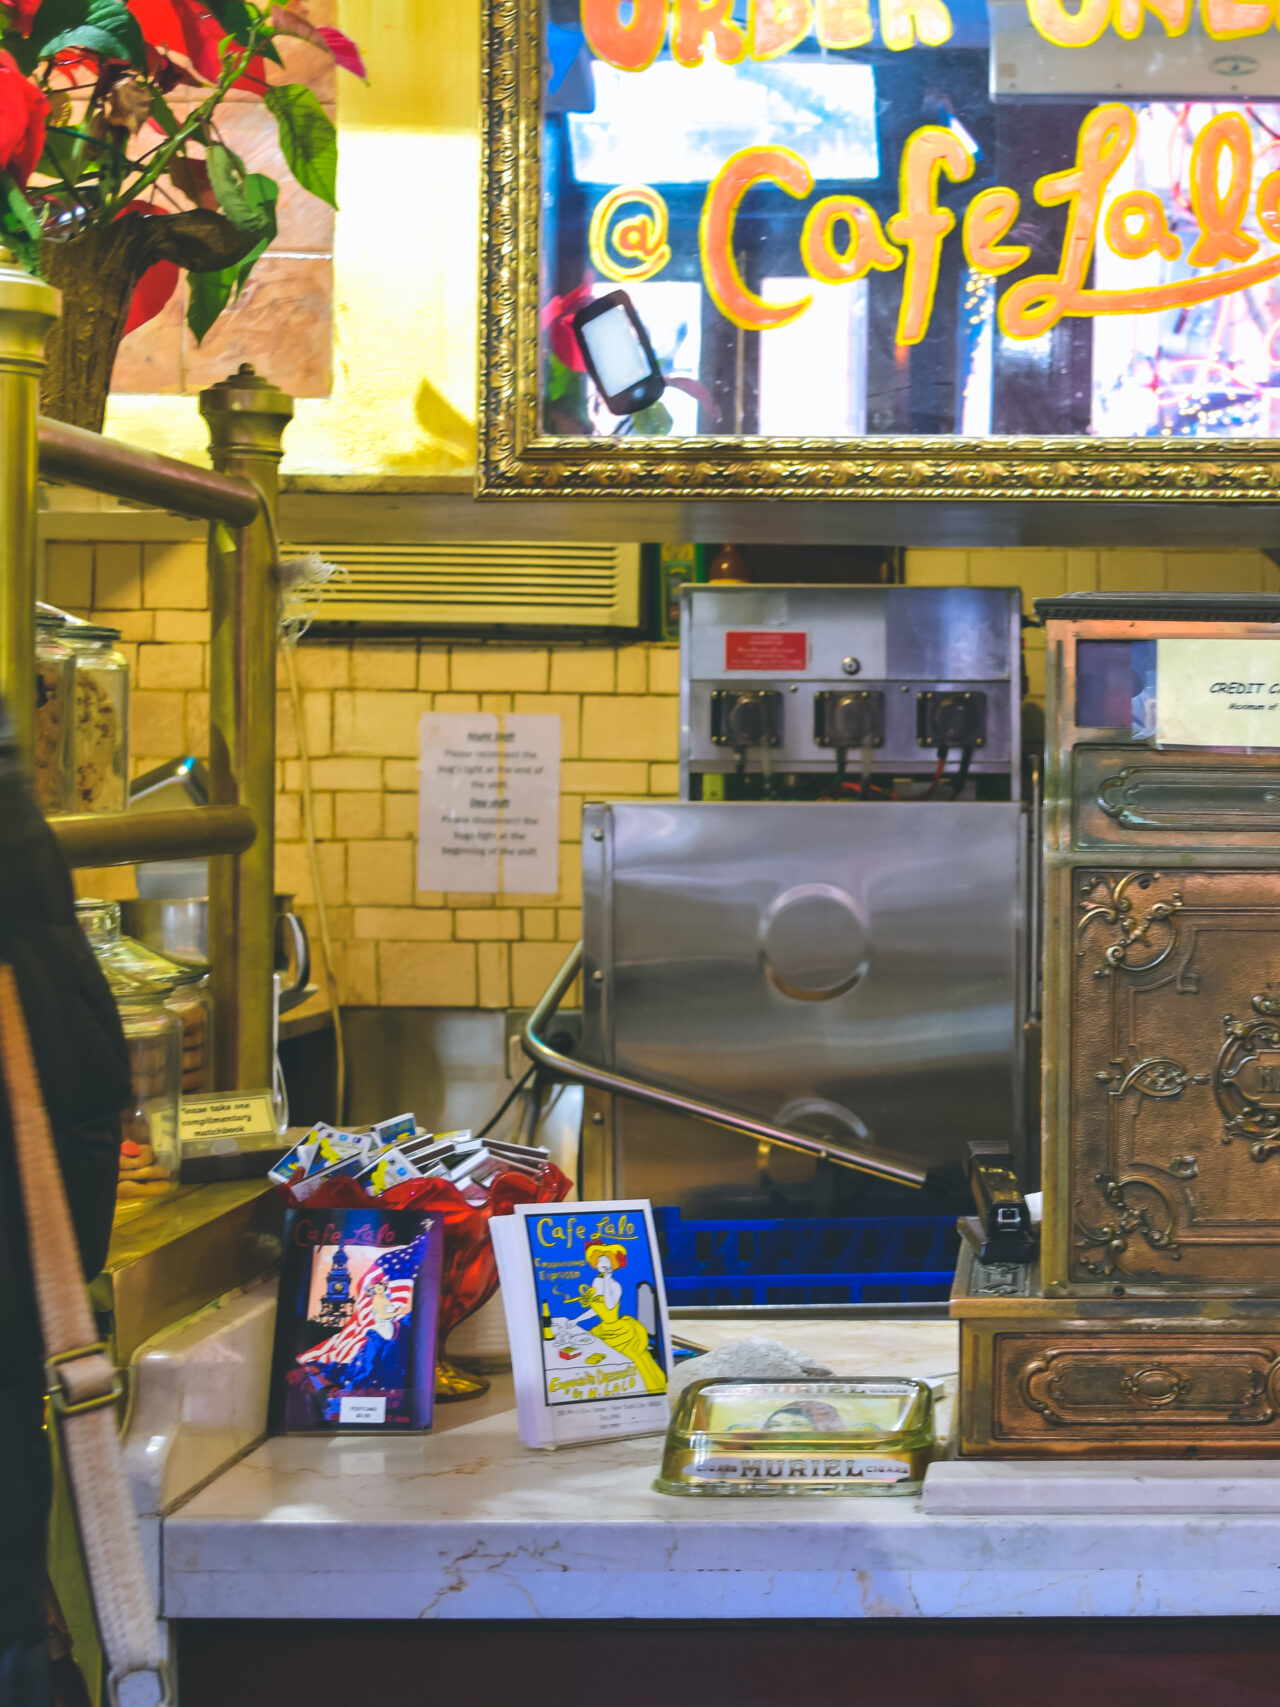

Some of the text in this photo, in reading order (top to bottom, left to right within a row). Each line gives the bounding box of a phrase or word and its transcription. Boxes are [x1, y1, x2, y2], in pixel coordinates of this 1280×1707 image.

[1209, 682, 1266, 695] CREDIT
[295, 1219, 397, 1253] Cafe Lalo
[537, 1214, 639, 1249] Cafe Lalo
[741, 1458, 864, 1478] MURIEL
